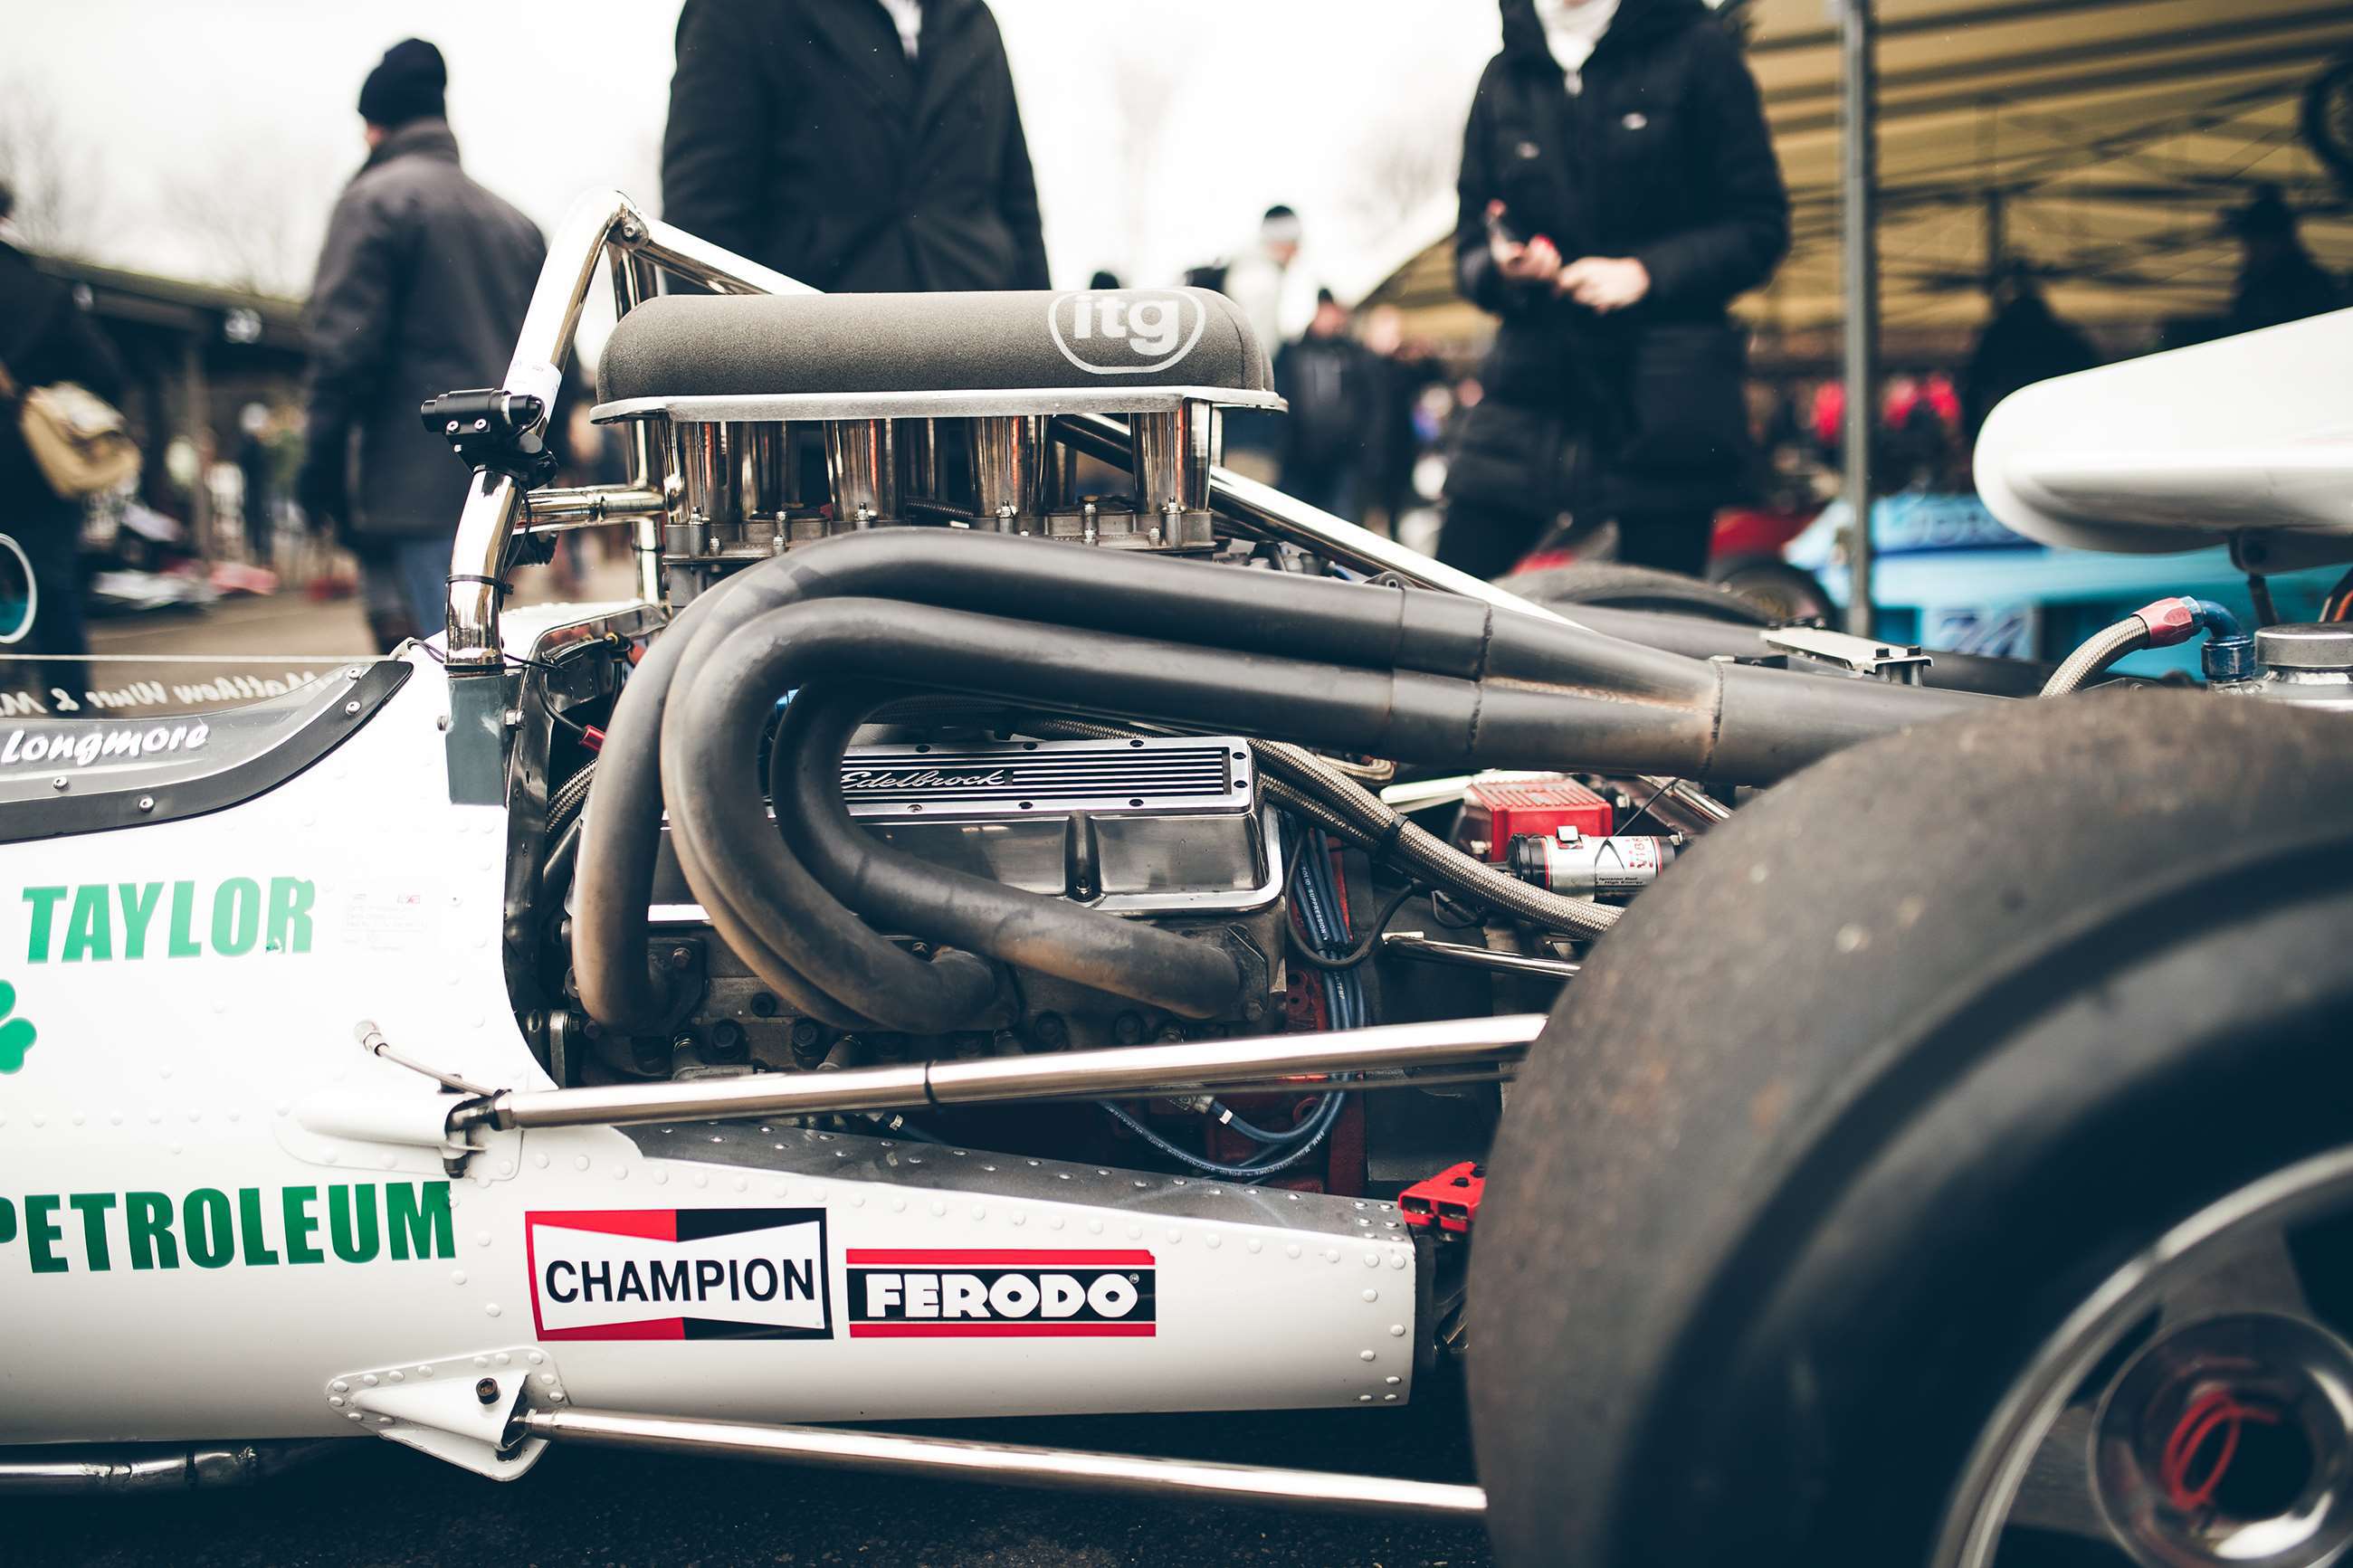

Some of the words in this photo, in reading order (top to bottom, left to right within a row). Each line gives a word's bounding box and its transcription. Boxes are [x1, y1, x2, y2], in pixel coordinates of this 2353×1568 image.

[1073, 294, 1180, 356] itg
[0, 723, 210, 766] Longmore
[841, 769, 1005, 789] Edelbrock
[22, 876, 316, 965] TAYLOR
[1308, 889, 1327, 935] SUPPRESSION
[545, 1258, 814, 1304] CHAMPION
[865, 1272, 1138, 1318] FERODO
